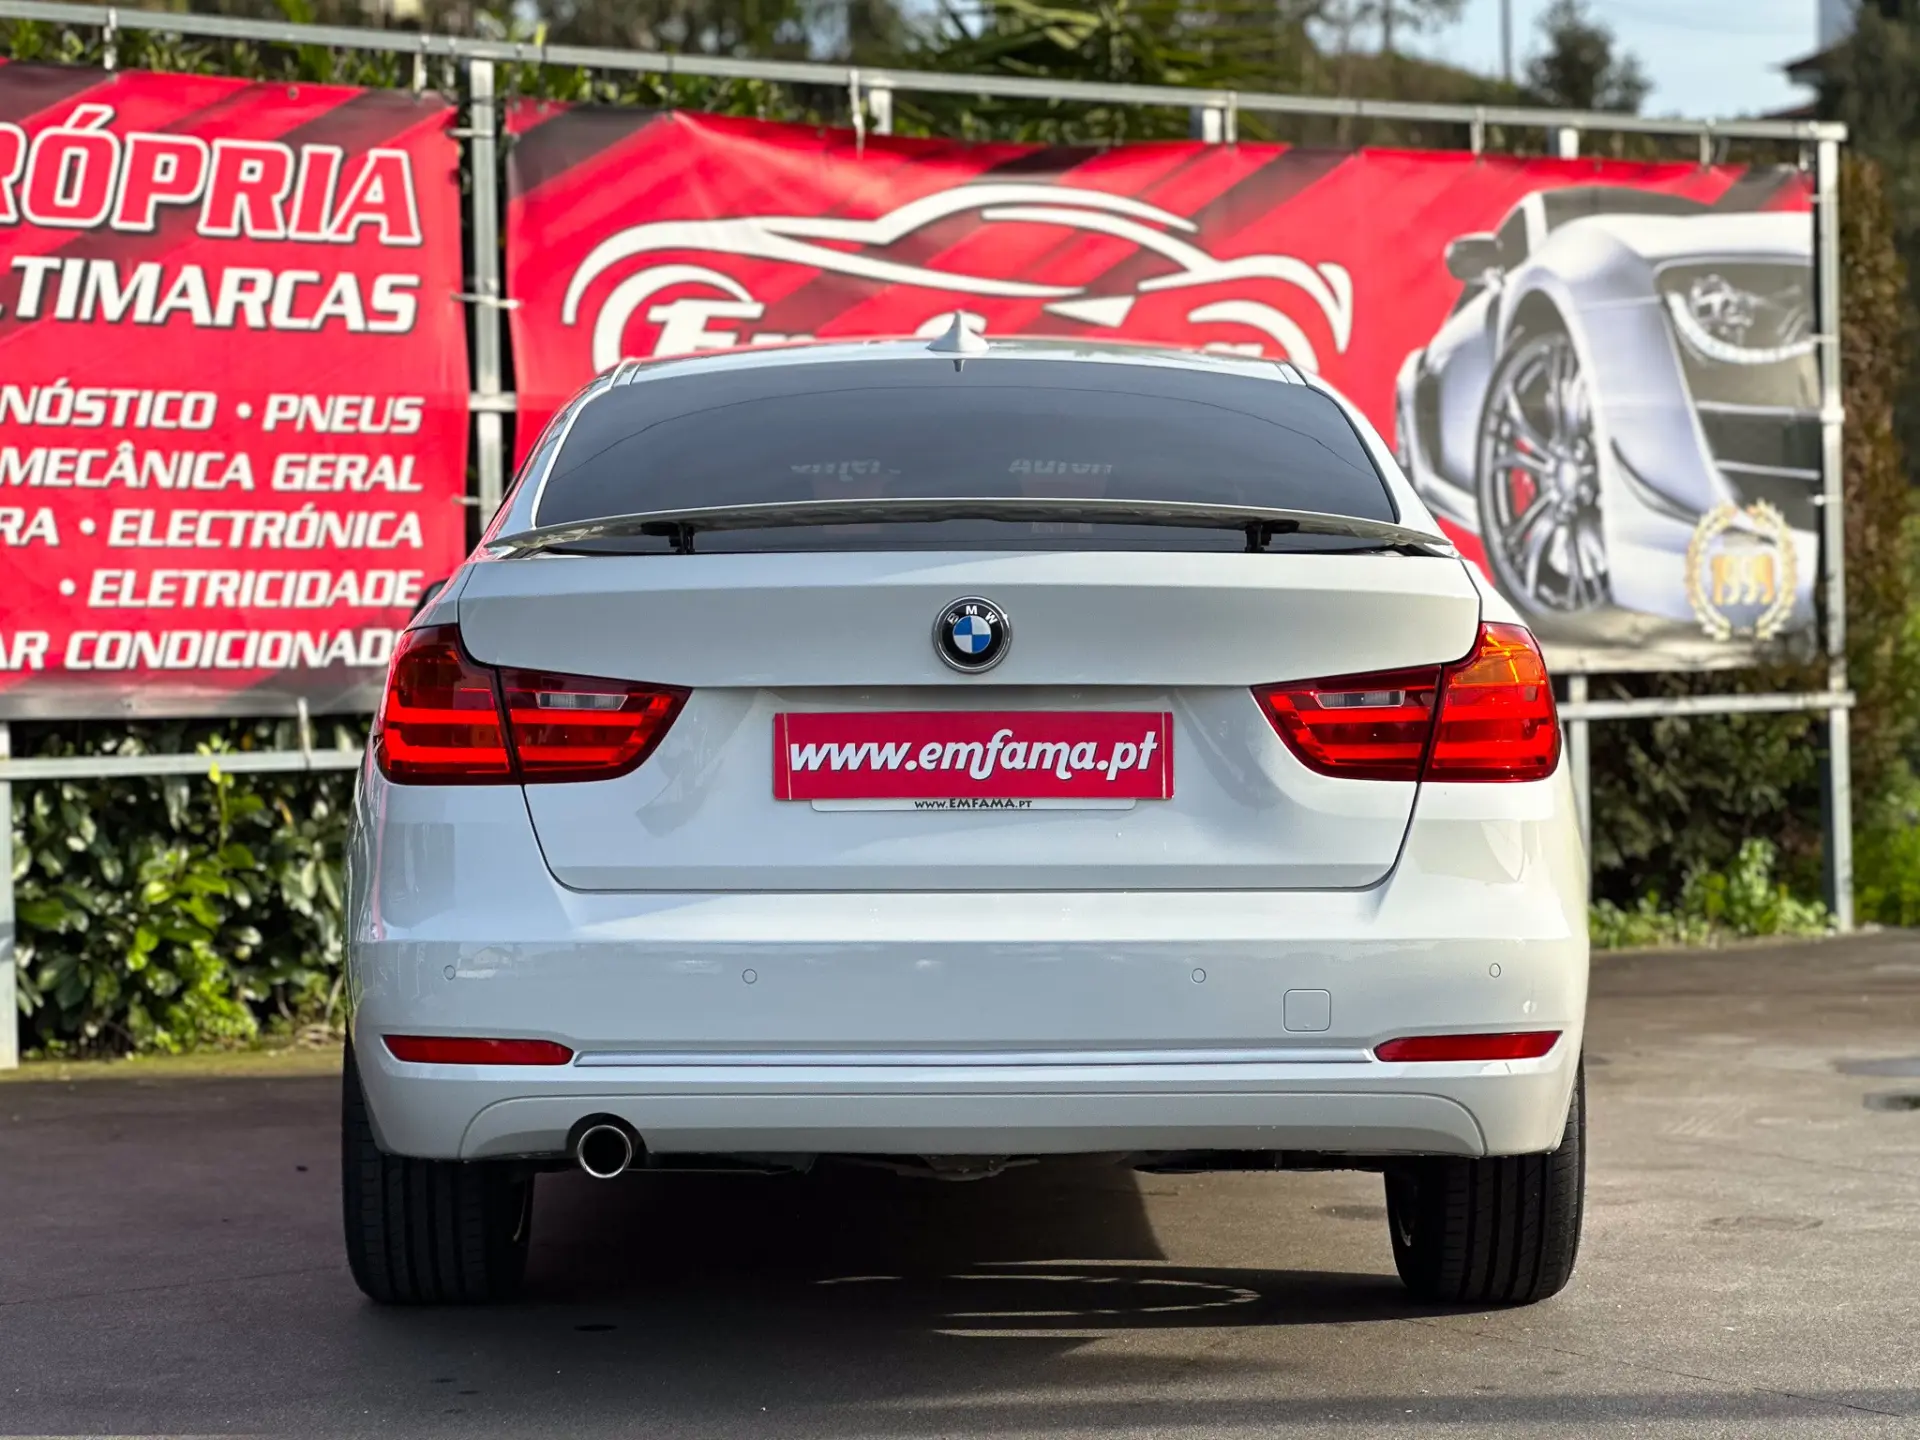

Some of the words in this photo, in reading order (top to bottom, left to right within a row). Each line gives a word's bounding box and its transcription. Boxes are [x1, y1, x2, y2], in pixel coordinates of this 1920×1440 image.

[11, 256, 421, 333] TIMARCAS
[0, 377, 217, 431] NÓSTICO
[262, 394, 424, 433] PNEUS
[0, 441, 254, 490] MECÂNICA
[271, 453, 423, 492] GERAL
[107, 503, 423, 549] ELECTRÓNICA
[88, 569, 424, 608] ELETRICIDADE
[947, 605, 998, 625] BMW
[0, 630, 49, 670] R
[64, 629, 405, 671] CONDICIONAD
[790, 728, 1158, 781] www.emfama.pt
